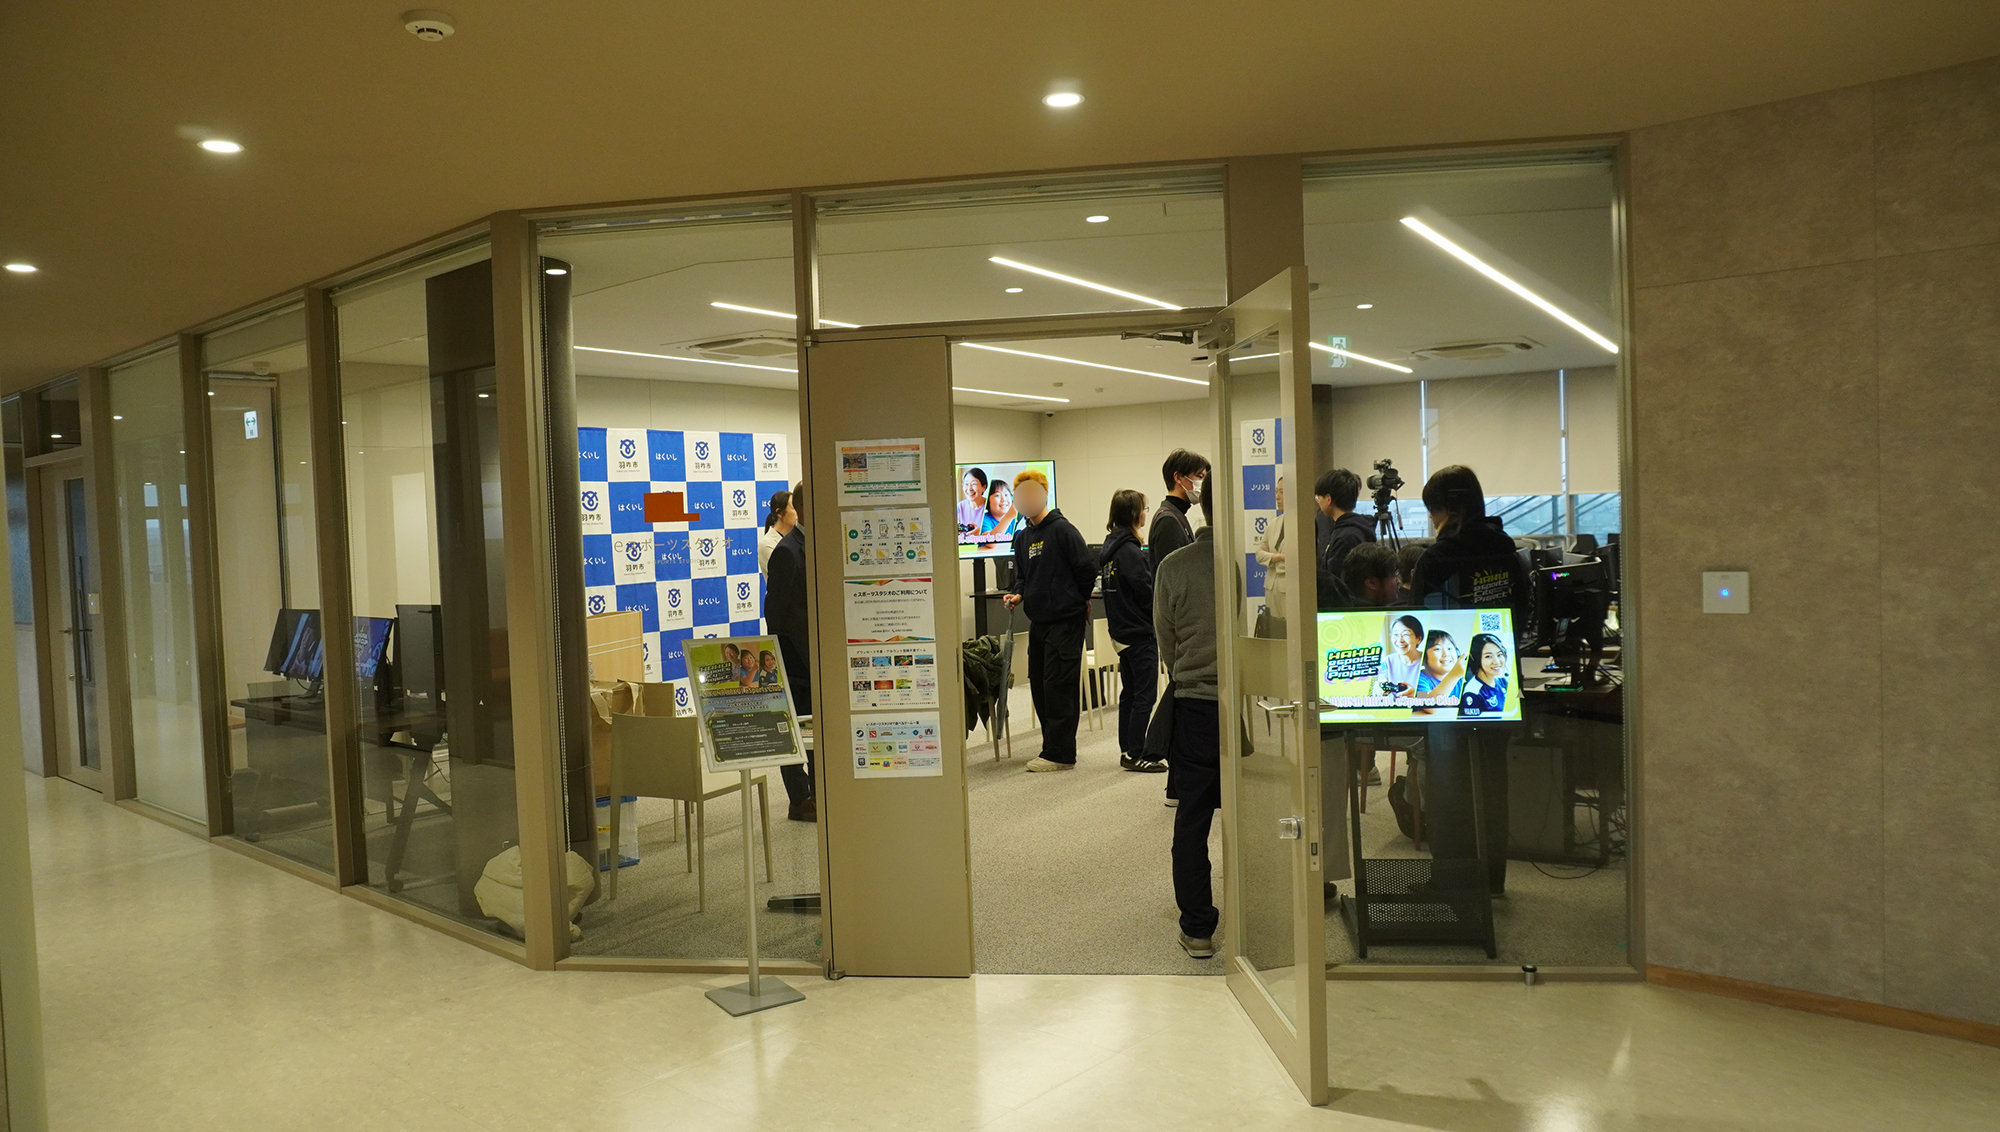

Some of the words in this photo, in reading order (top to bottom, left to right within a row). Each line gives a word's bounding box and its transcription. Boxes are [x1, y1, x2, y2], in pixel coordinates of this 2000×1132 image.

[655, 452, 678, 461] はくいし
[726, 454, 748, 462] はくいし
[618, 503, 643, 512] はくいし
[694, 502, 716, 510] はくいし
[614, 536, 734, 553] eスポーツスタジオ
[731, 548, 752, 556] はくいし
[661, 553, 682, 561] はくいし
[1473, 572, 1509, 586] HAKUI
[697, 597, 721, 606] はくいし
[668, 651, 685, 659] はくい
[1328, 647, 1381, 660] HAKUI
[1328, 655, 1380, 666] esports
[1328, 664, 1356, 672] City
[1328, 668, 1377, 679] Project
[1364, 695, 1393, 707] HAKUI
[1436, 694, 1459, 706] Club
